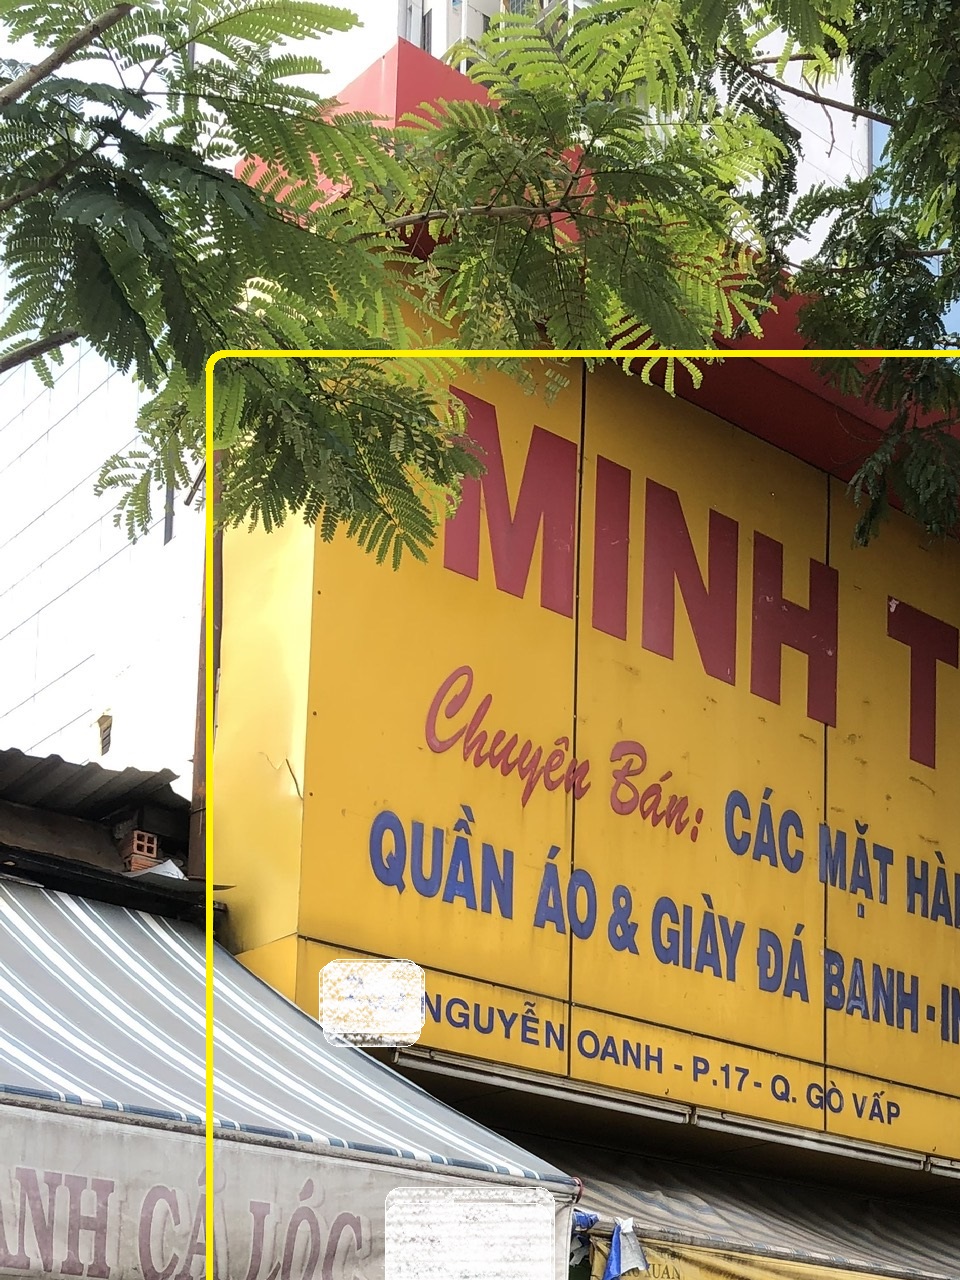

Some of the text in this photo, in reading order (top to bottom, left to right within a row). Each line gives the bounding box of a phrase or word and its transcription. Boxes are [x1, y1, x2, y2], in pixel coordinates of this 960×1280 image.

[443, 385, 839, 728] MINH
[425, 665, 592, 808] Chuyên
[609, 740, 704, 842] Bán:
[725, 787, 804, 874] CÁC
[818, 818, 894, 918] MẶT
[369, 804, 515, 920] QUẦN
[533, 845, 598, 940] ÁO
[607, 884, 639, 955] &
[651, 893, 746, 982] GIÀY
[757, 923, 809, 1003] ĐÁ
[824, 947, 919, 1033] BANH
[421, 996, 902, 1126] NGUYỄN OANH P.17 Q. GÒ VẤP
[0, 1166, 115, 1279] NH
